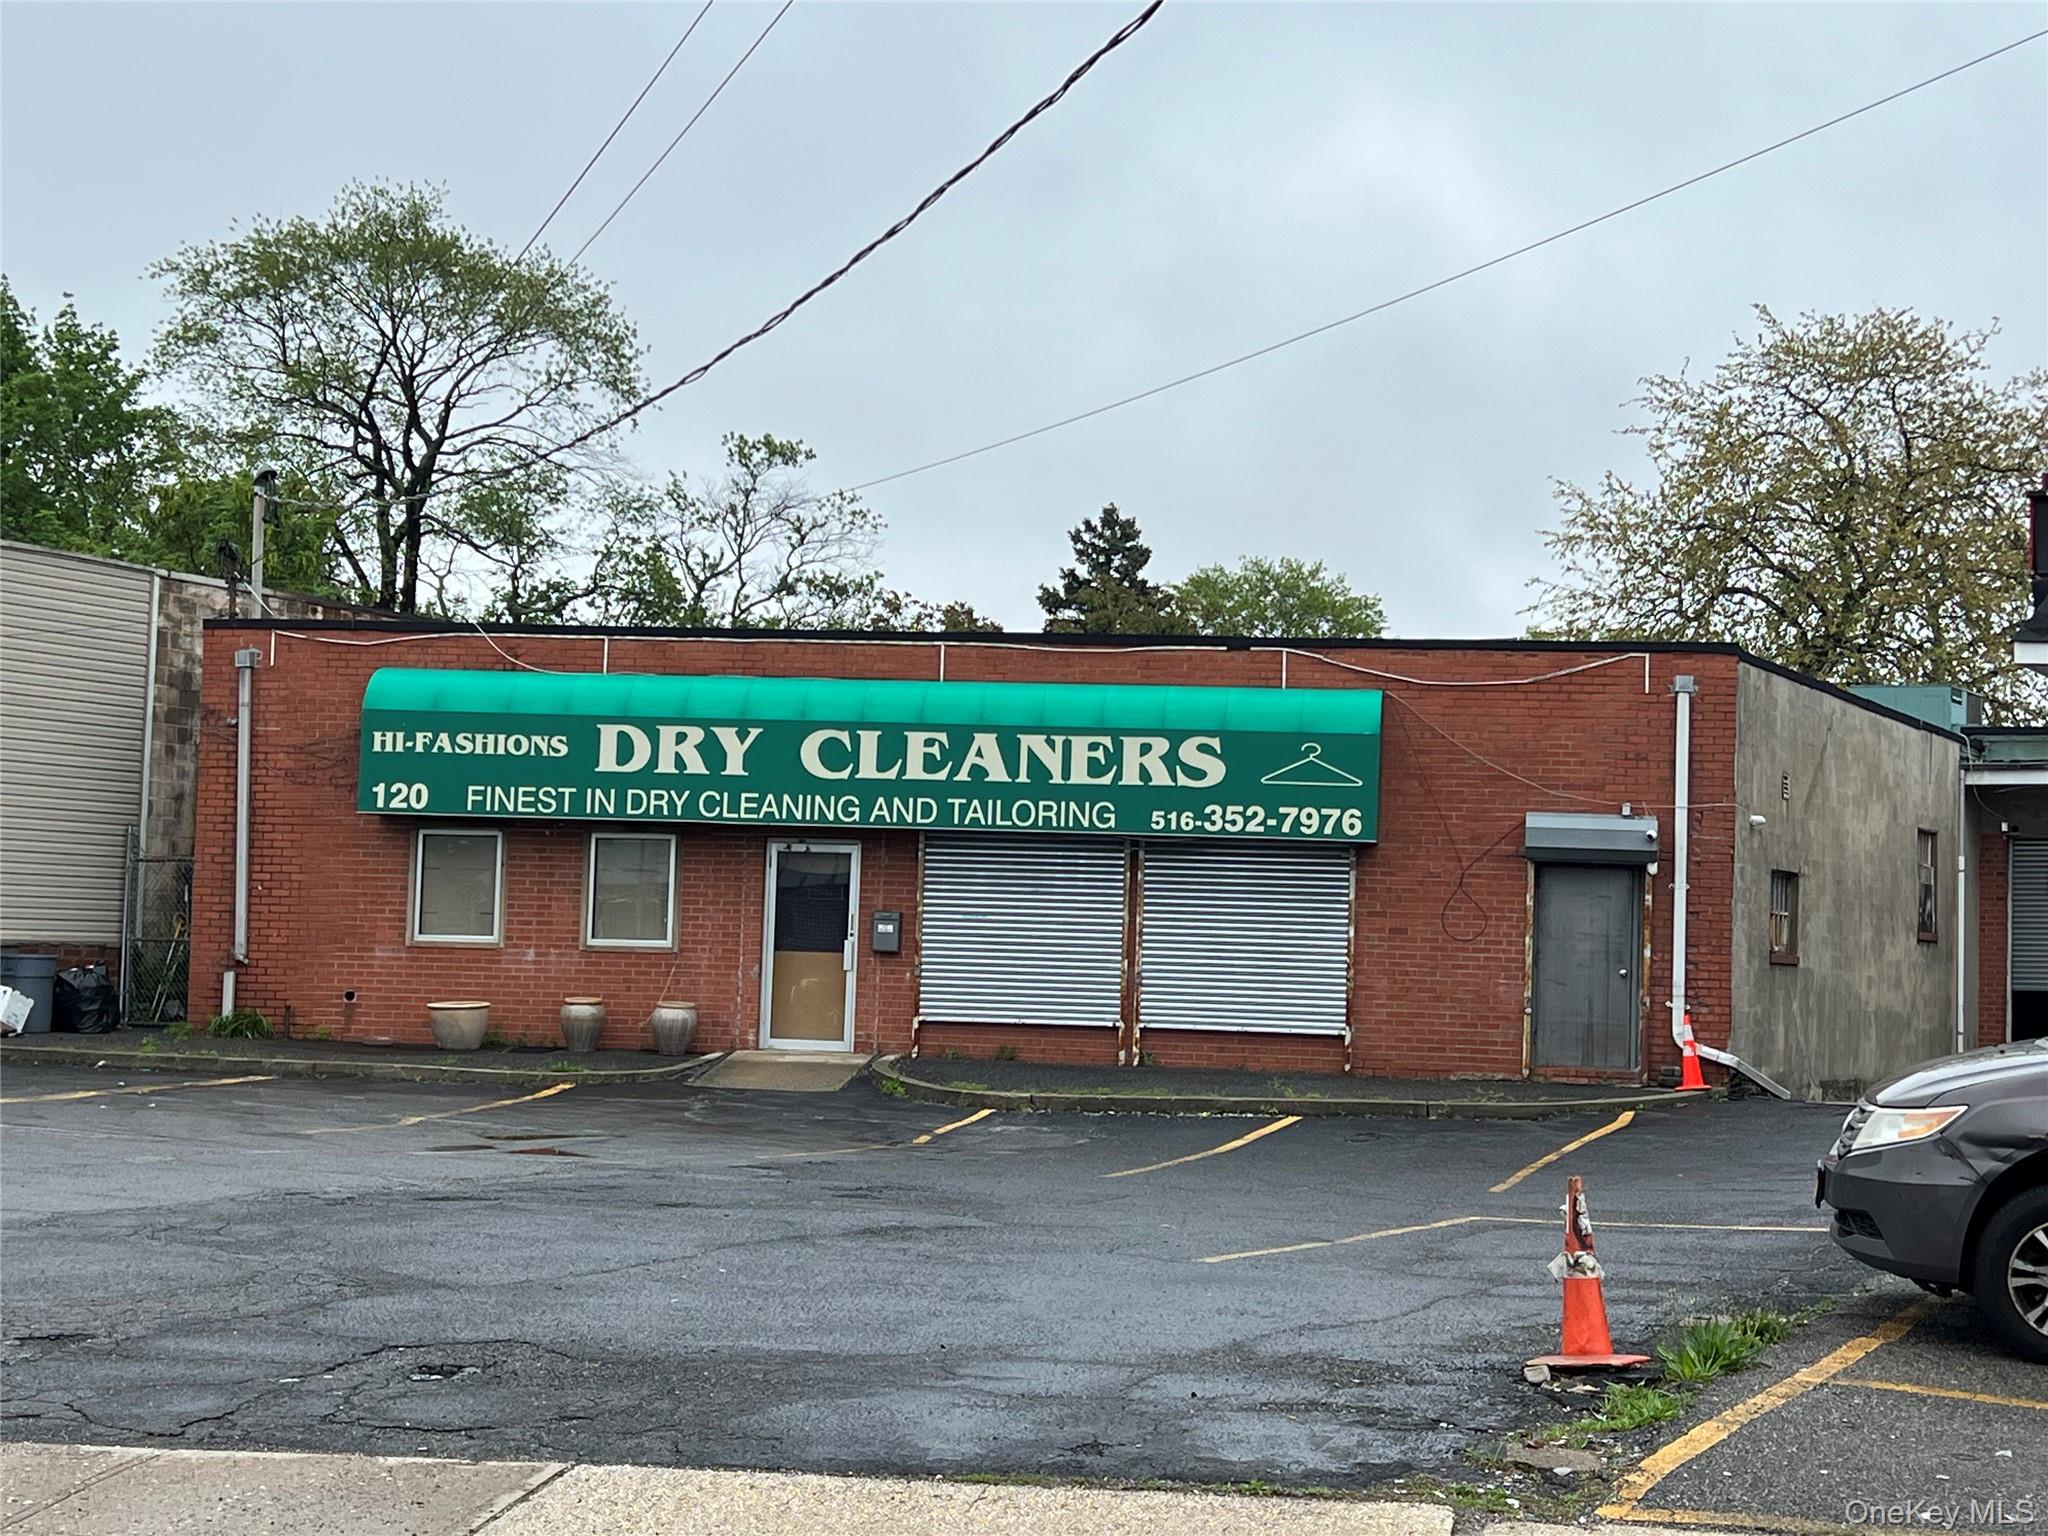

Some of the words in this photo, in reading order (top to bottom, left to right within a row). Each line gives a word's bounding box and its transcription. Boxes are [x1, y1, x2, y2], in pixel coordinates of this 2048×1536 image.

[372, 731, 569, 757] HI-FASHIONS
[594, 724, 764, 776] DRY
[799, 729, 1227, 788] CLEANERS
[372, 782, 429, 810] 120
[467, 785, 577, 814] FINEST
[586, 788, 616, 815] IN
[626, 788, 691, 817] DRY
[698, 790, 860, 823] CLEANING
[869, 796, 938, 824] AND
[947, 798, 1116, 829] TAILORING
[1150, 804, 1362, 837] 516-352-7976
